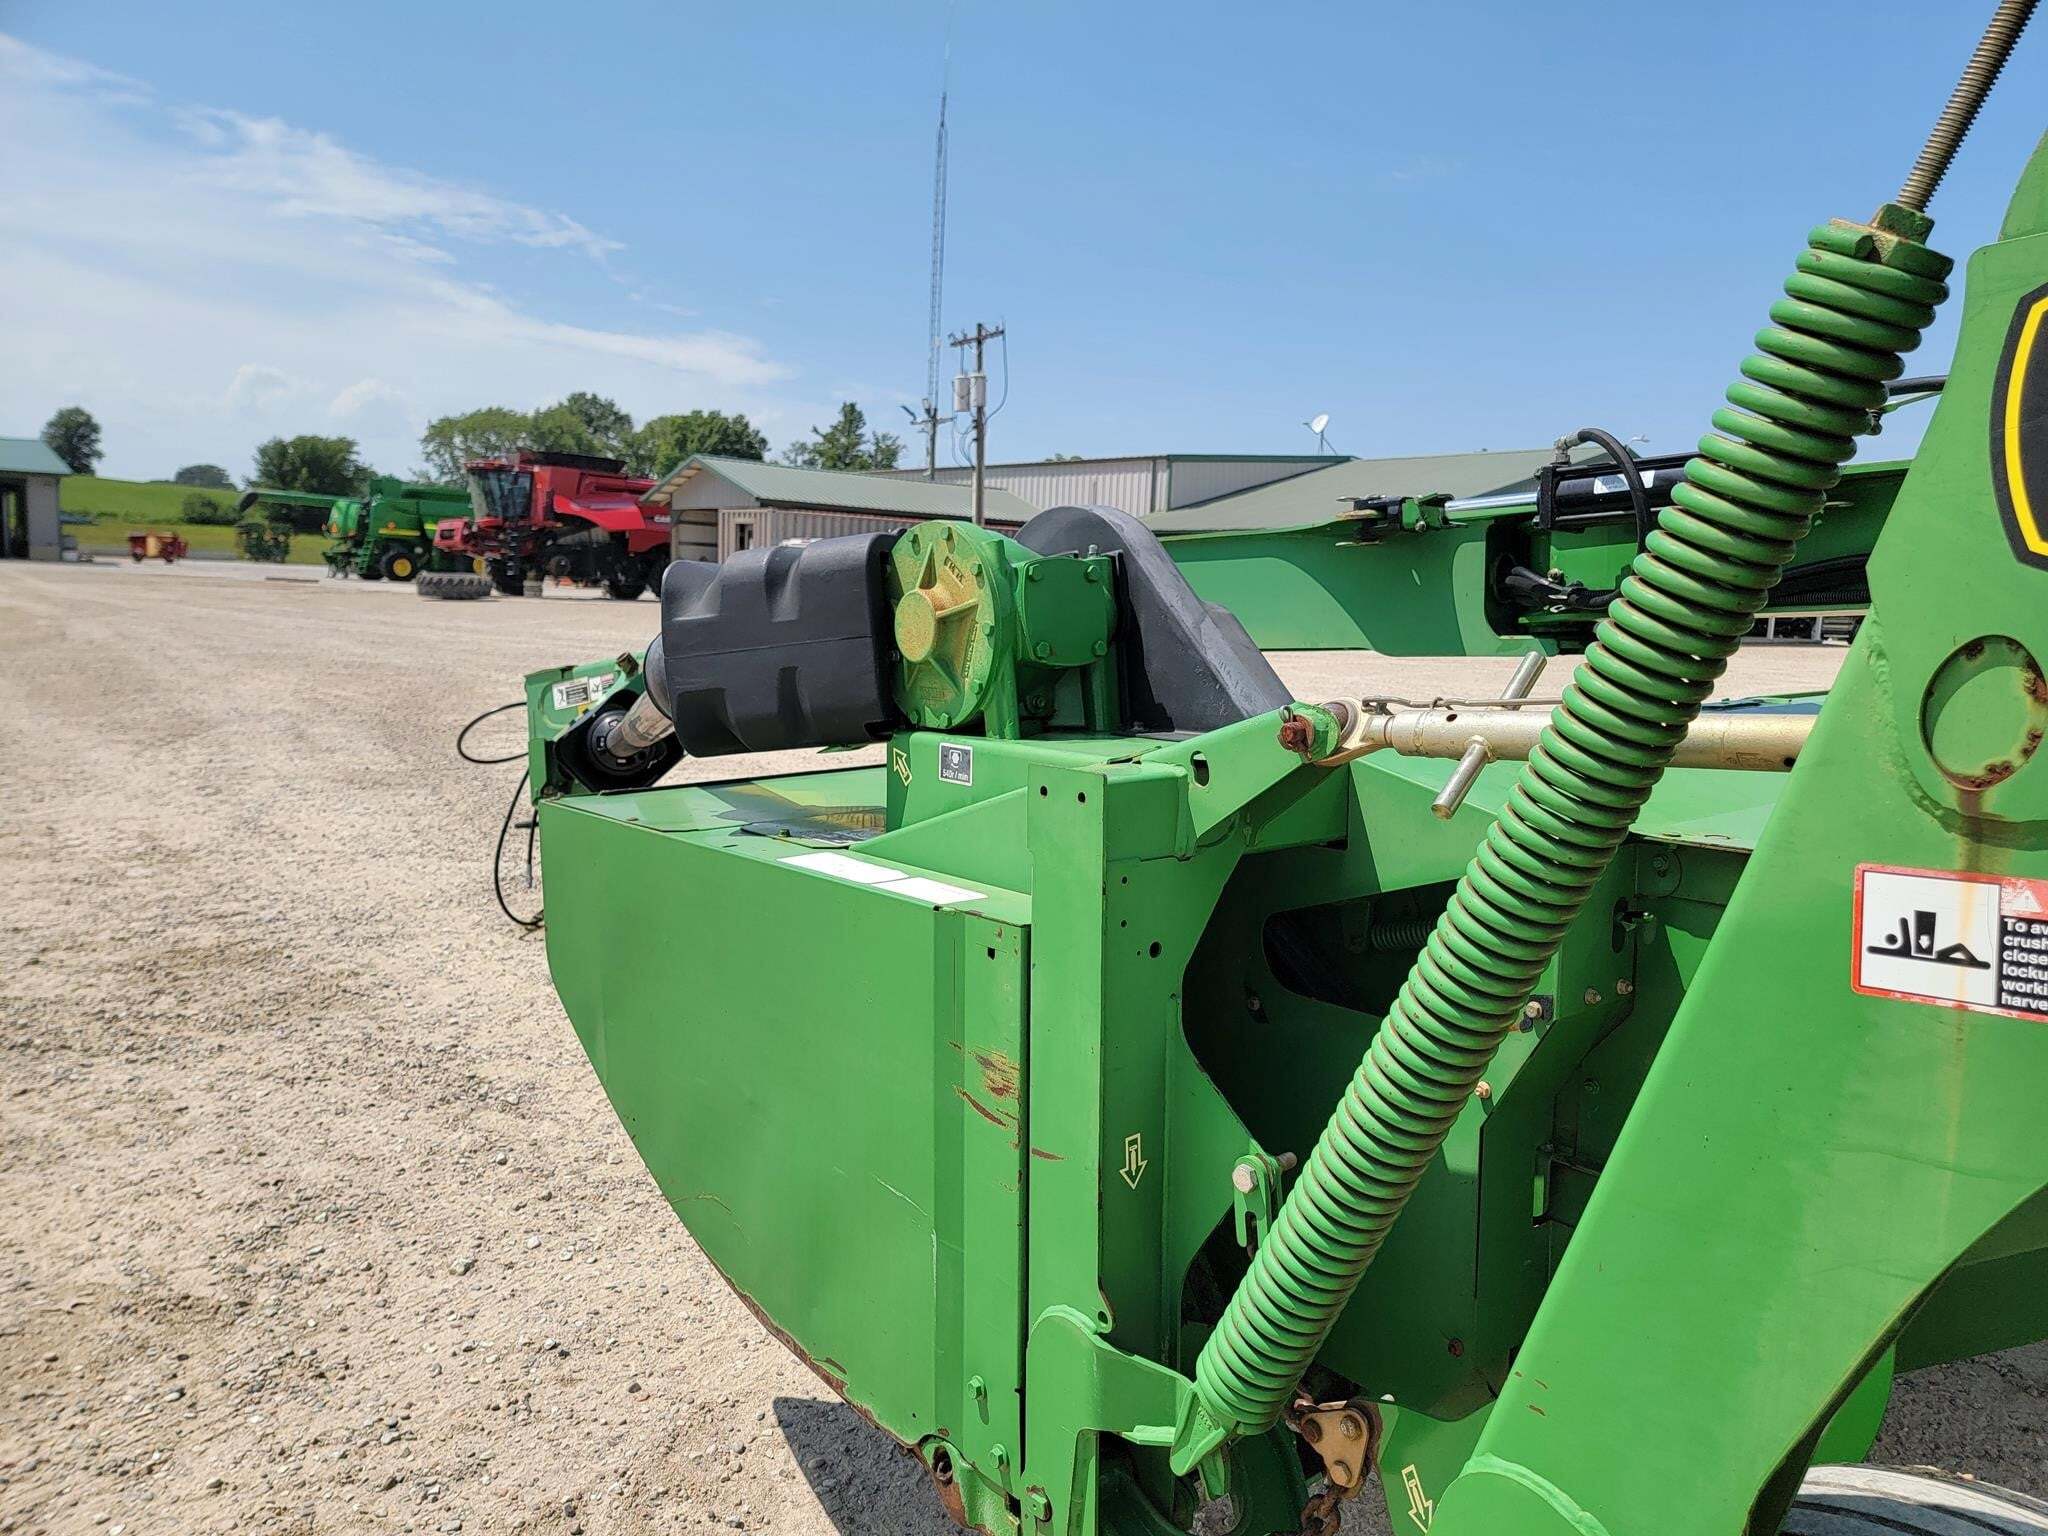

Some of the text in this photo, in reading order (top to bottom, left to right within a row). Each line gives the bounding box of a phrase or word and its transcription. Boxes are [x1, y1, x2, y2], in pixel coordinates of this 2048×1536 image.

[2003, 918, 2028, 932] To
[2002, 949, 2048, 966] close
[2002, 962, 2048, 981] locku
[2001, 980, 2048, 996] worki
[2001, 992, 2048, 1011] harve
